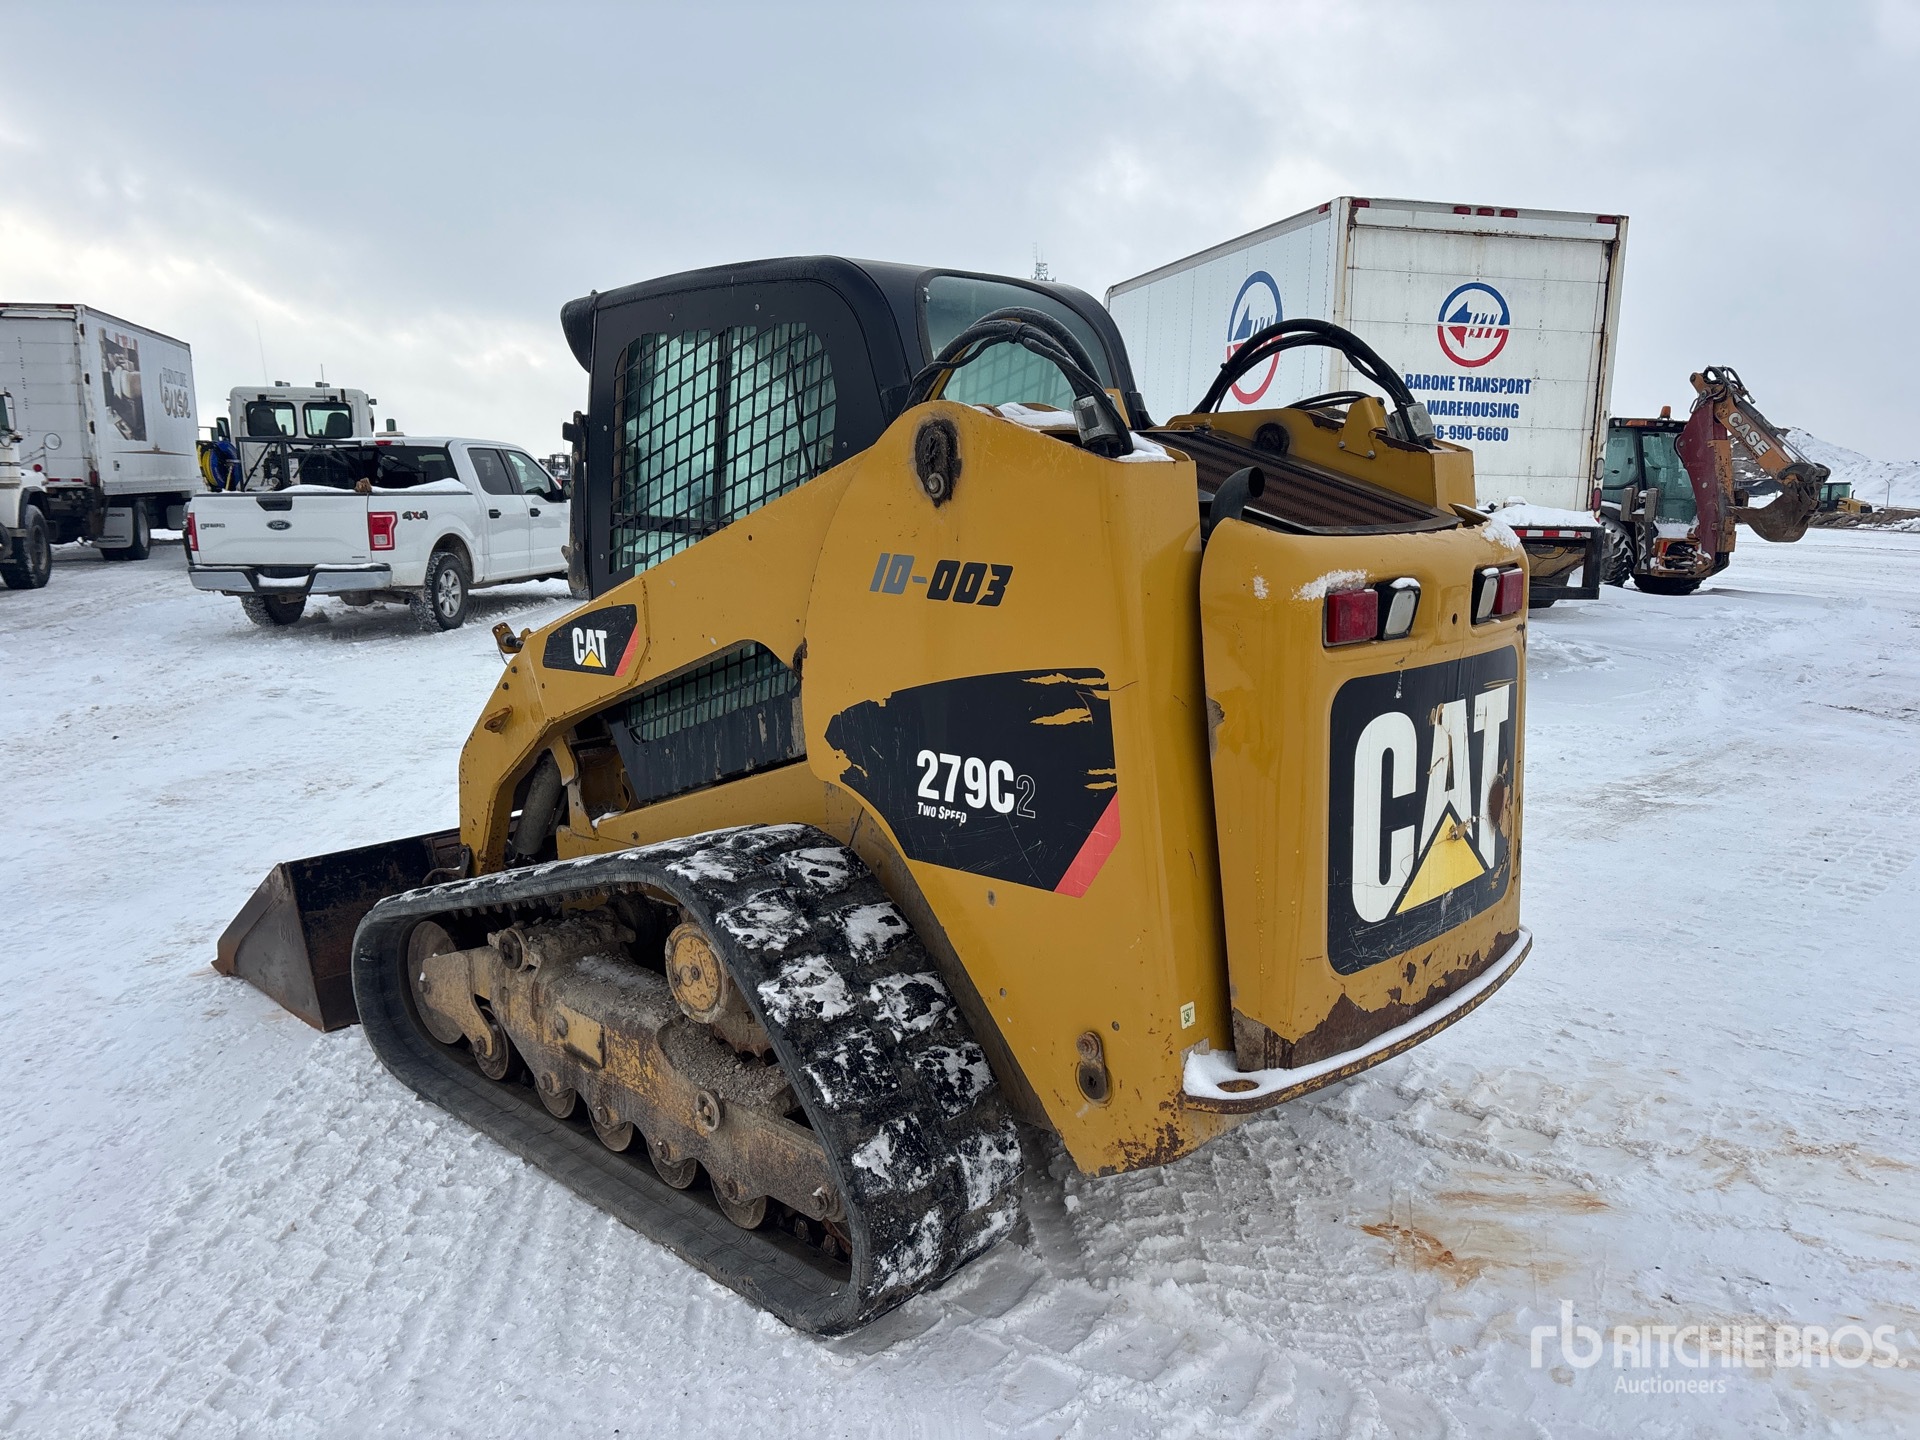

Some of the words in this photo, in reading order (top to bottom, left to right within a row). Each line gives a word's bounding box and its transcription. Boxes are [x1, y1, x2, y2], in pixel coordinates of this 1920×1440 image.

[1405, 373, 1455, 391] BARONE
[1458, 376, 1532, 395] TRANSPORT
[1427, 400, 1519, 418] WAREHOUSING
[1433, 425, 1509, 441] 16-990-6660
[1728, 412, 1771, 456] CASE
[572, 627, 607, 668] CAT
[1352, 684, 1509, 923] CAT
